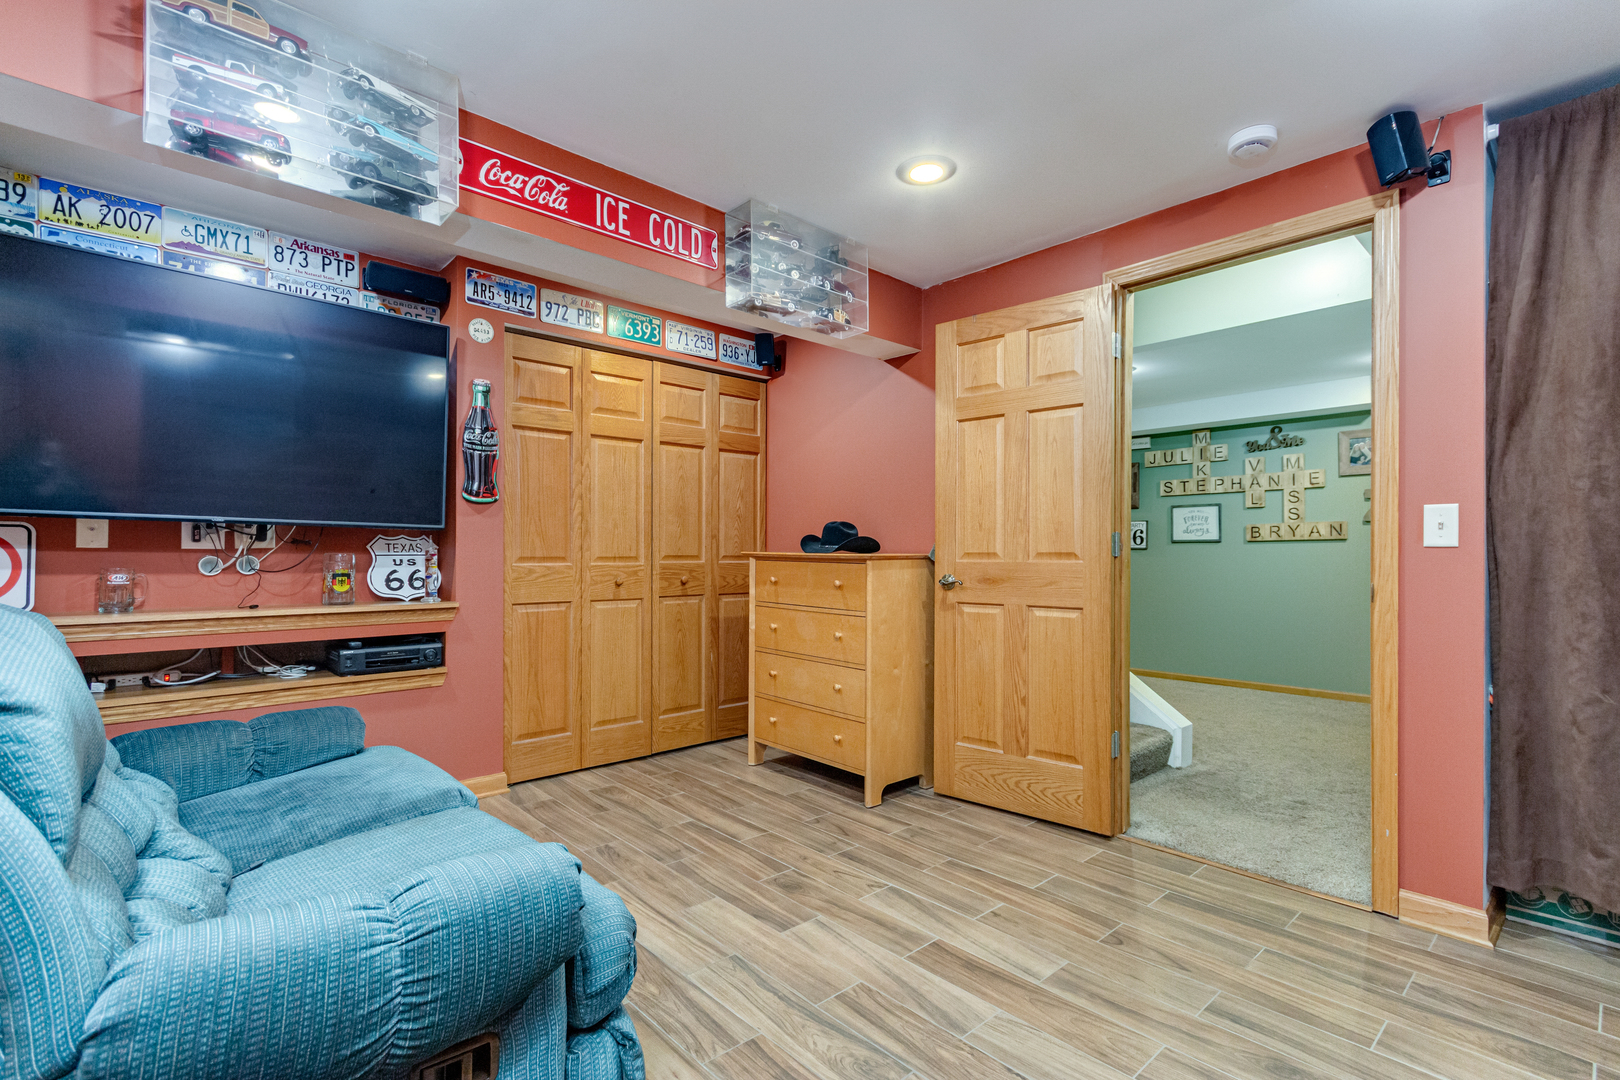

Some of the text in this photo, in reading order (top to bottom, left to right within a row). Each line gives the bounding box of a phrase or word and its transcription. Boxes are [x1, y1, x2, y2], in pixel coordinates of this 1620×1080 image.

[53, 193, 156, 235] AK 2007
[191, 216, 243, 232] ARIZONA
[595, 193, 631, 236] ICE
[648, 213, 702, 259] COLD
[75, 235, 129, 252] Connecticut
[194, 223, 254, 256] GMX71
[290, 238, 341, 259] Arkansas
[273, 244, 309, 269] 873
[321, 255, 356, 279] PTP
[305, 280, 353, 297] GEORGIA
[490, 275, 514, 286] TEXAS
[382, 298, 420, 310] FLORIDA
[472, 281, 533, 311] AR5 9412
[545, 301, 569, 322] 972
[620, 311, 650, 322] VERMONT
[624, 318, 660, 342] 6393
[676, 330, 714, 351] 71-259
[722, 338, 748, 348] WASHINGTON
[722, 343, 756, 364] 936-YJ
[1149, 446, 1224, 465] JULIE
[1195, 432, 1209, 492] MIKE
[1163, 471, 1320, 494] STEPHANIE
[1132, 529, 1145, 546] 6
[1250, 523, 1343, 539] BRYAN
[385, 542, 423, 554] TEXAS
[392, 558, 417, 566] US
[384, 568, 425, 592] 66
